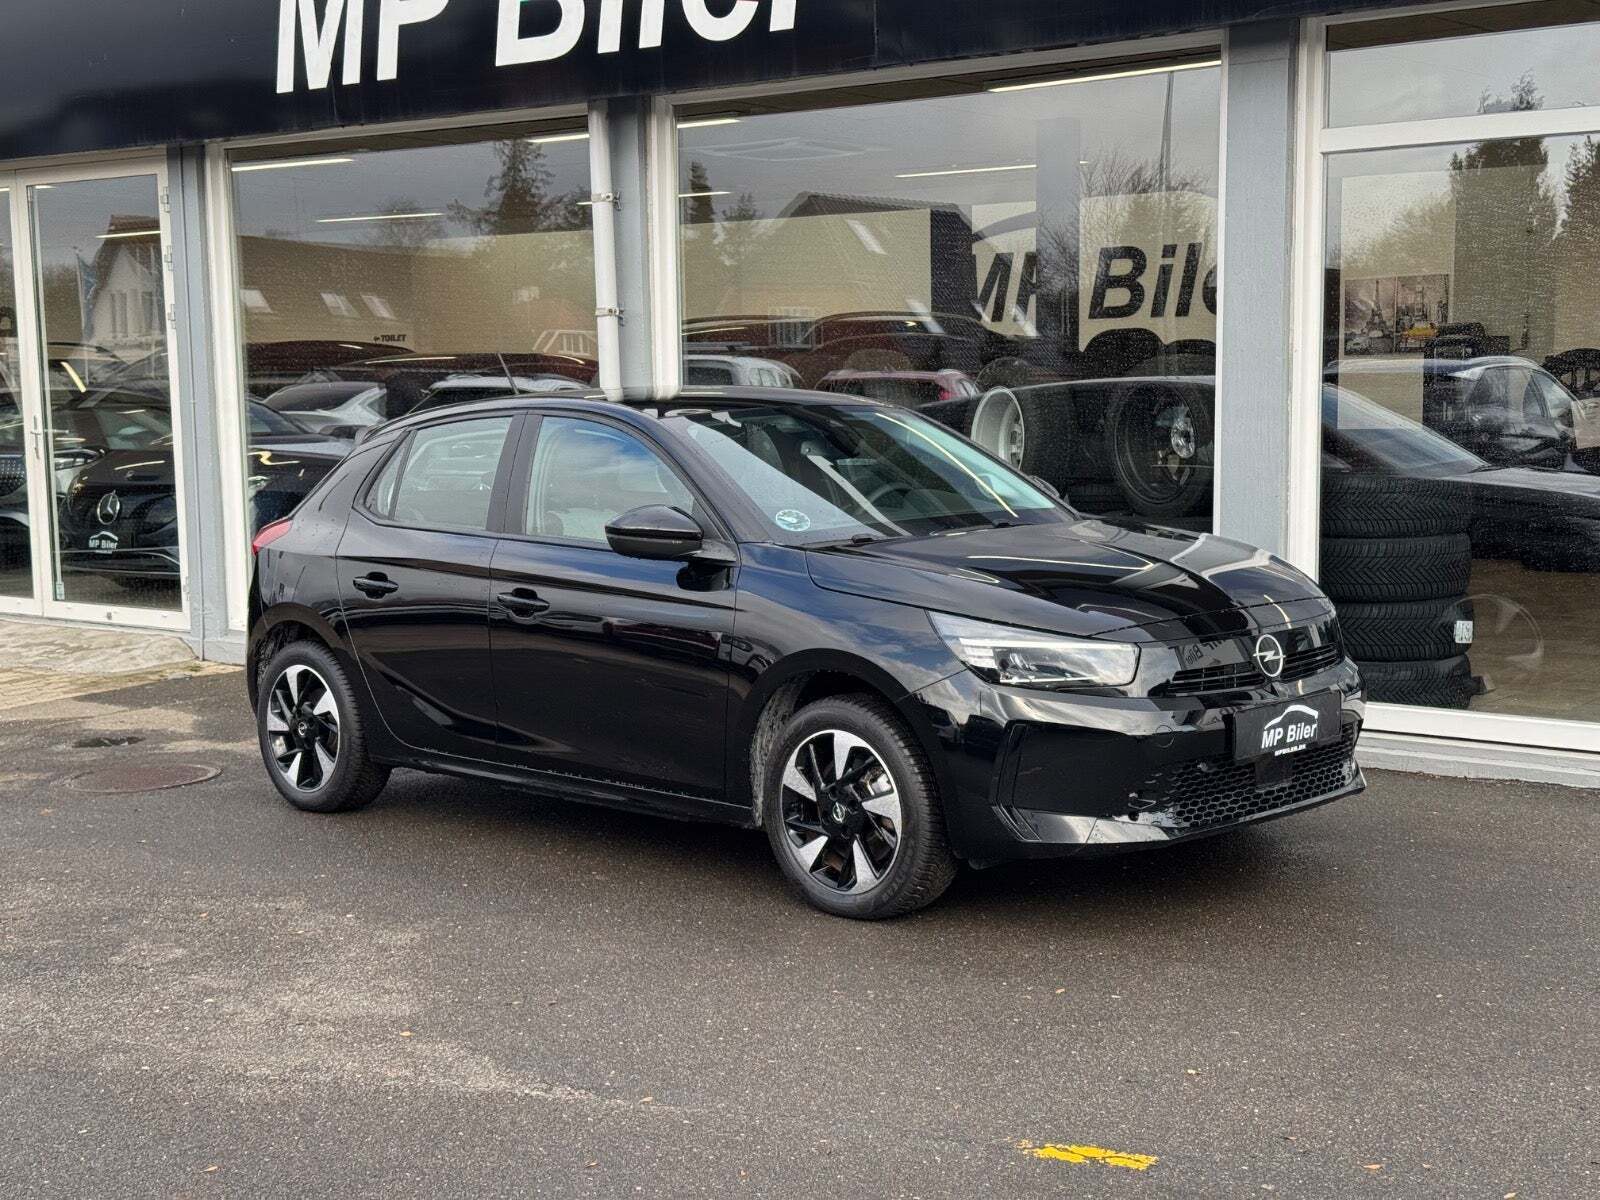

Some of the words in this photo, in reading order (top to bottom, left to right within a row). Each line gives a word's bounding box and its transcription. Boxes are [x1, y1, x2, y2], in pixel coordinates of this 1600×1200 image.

[380, 334, 407, 342] TOILET
[89, 539, 100, 548] MP
[101, 539, 118, 549] Biler
[1261, 730, 1283, 749] MP
[1286, 722, 1318, 743] Biler
